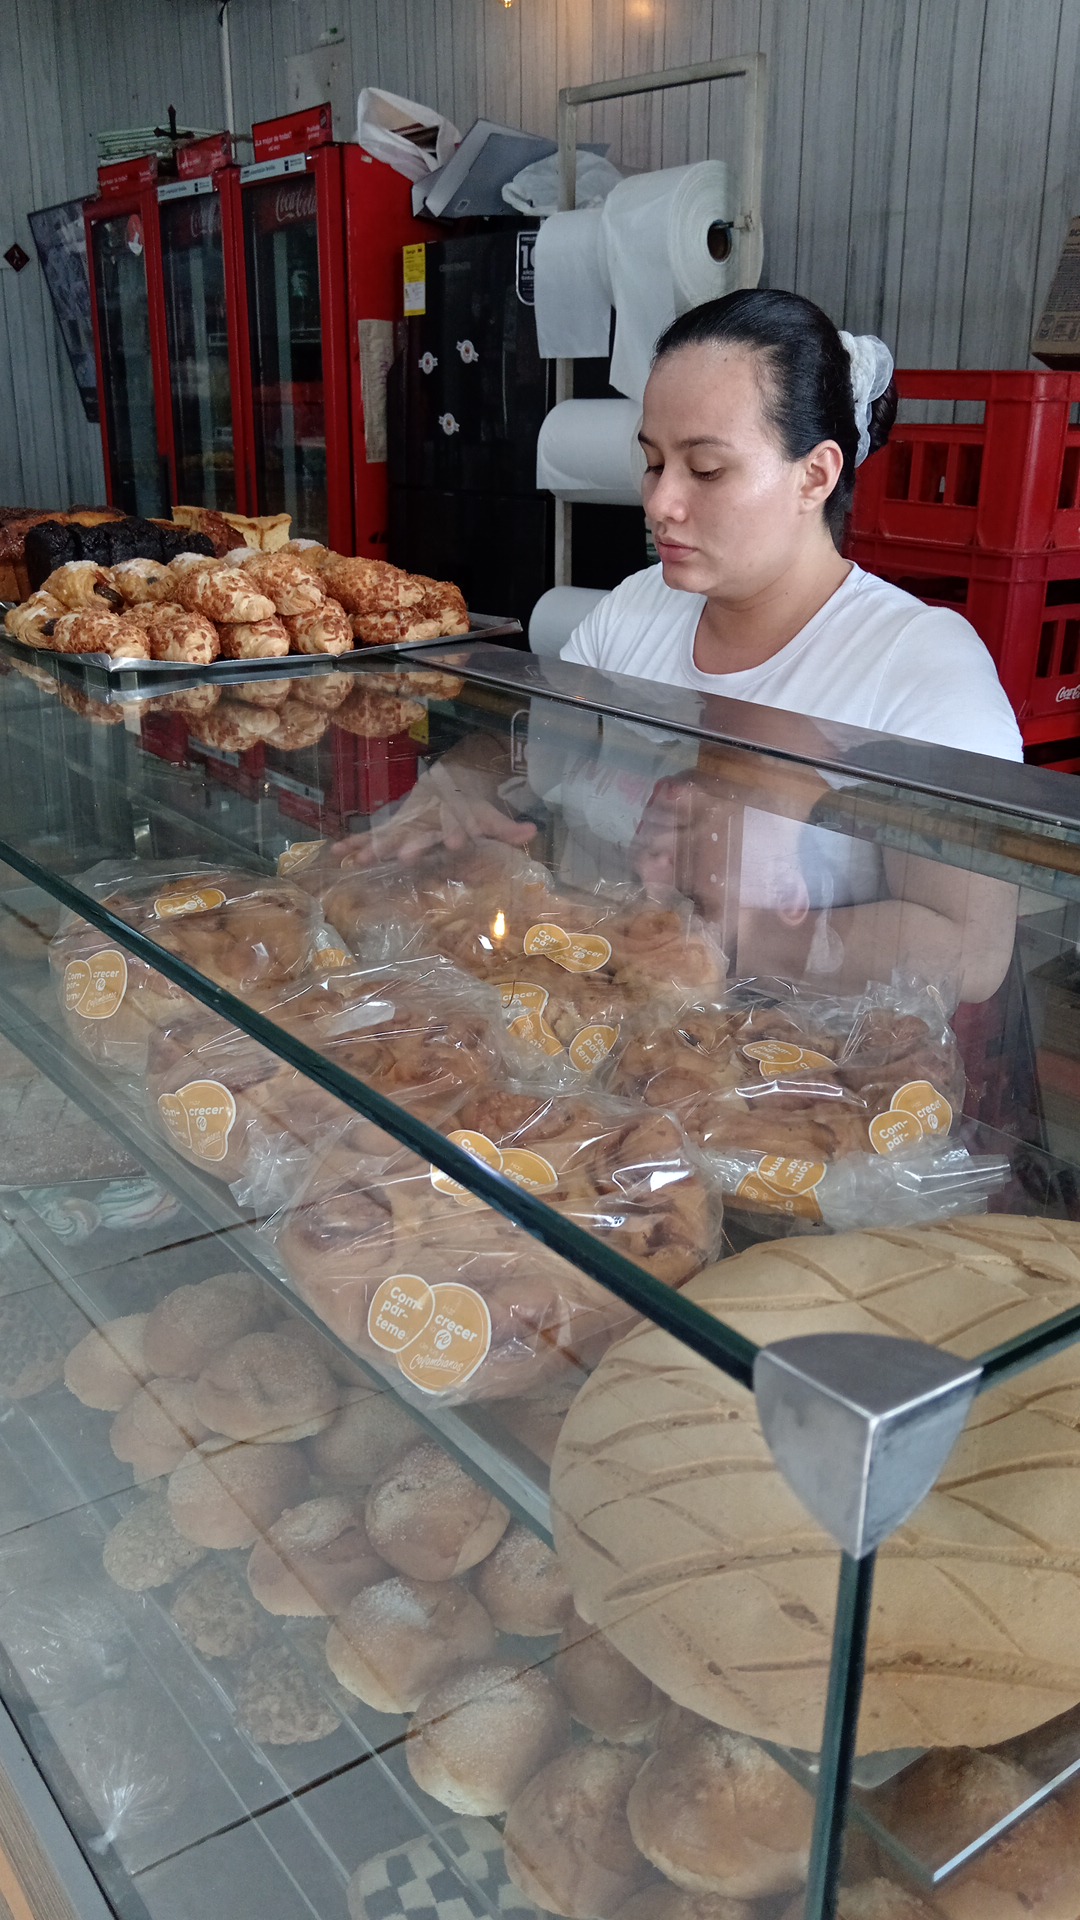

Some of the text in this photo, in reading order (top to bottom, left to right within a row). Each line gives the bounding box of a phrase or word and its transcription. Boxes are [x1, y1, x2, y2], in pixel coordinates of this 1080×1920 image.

[572, 945, 603, 958] crecer
[93, 970, 119, 978] crecer
[189, 1106, 224, 1116] crecer
[879, 1120, 908, 1139] Com-
[767, 1156, 786, 1177] eme
[390, 1286, 423, 1311] Com-
[381, 1300, 408, 1319] pár-
[375, 1314, 406, 1340] teme
[434, 1314, 477, 1342] crecer
[409, 1353, 464, 1372] Colombianos
